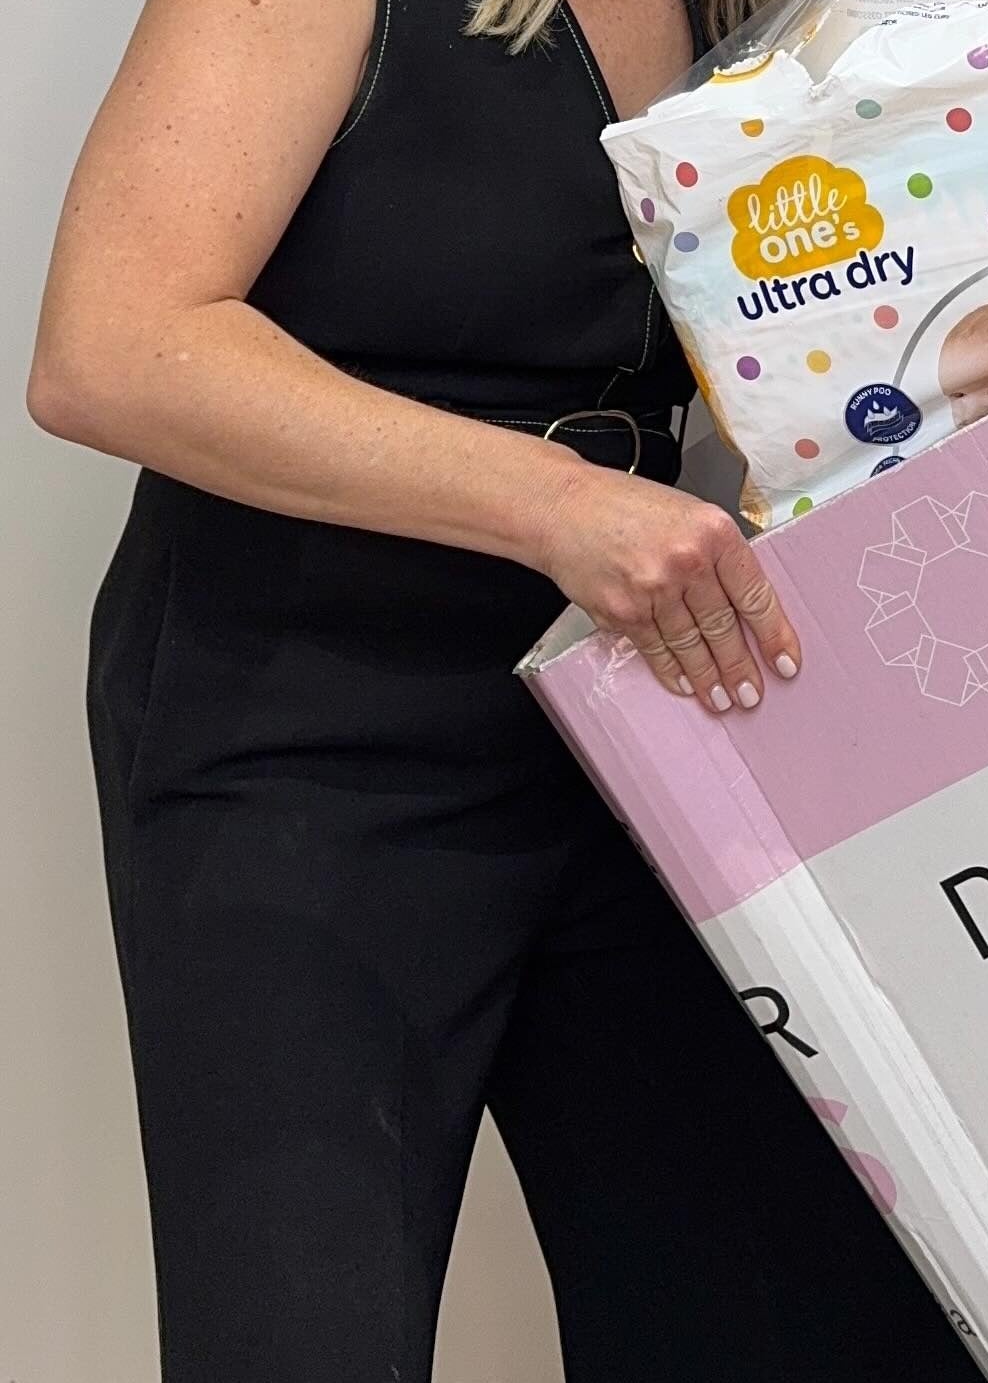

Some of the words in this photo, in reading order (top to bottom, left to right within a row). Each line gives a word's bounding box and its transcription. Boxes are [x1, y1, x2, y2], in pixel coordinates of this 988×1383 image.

[748, 173, 848, 234] little
[760, 213, 861, 263] one's
[737, 270, 841, 320] ultra
[846, 246, 914, 289] dry
[850, 388, 873, 411] RUNNY
[873, 387, 892, 396] POO
[872, 421, 917, 442] PROTECTION
